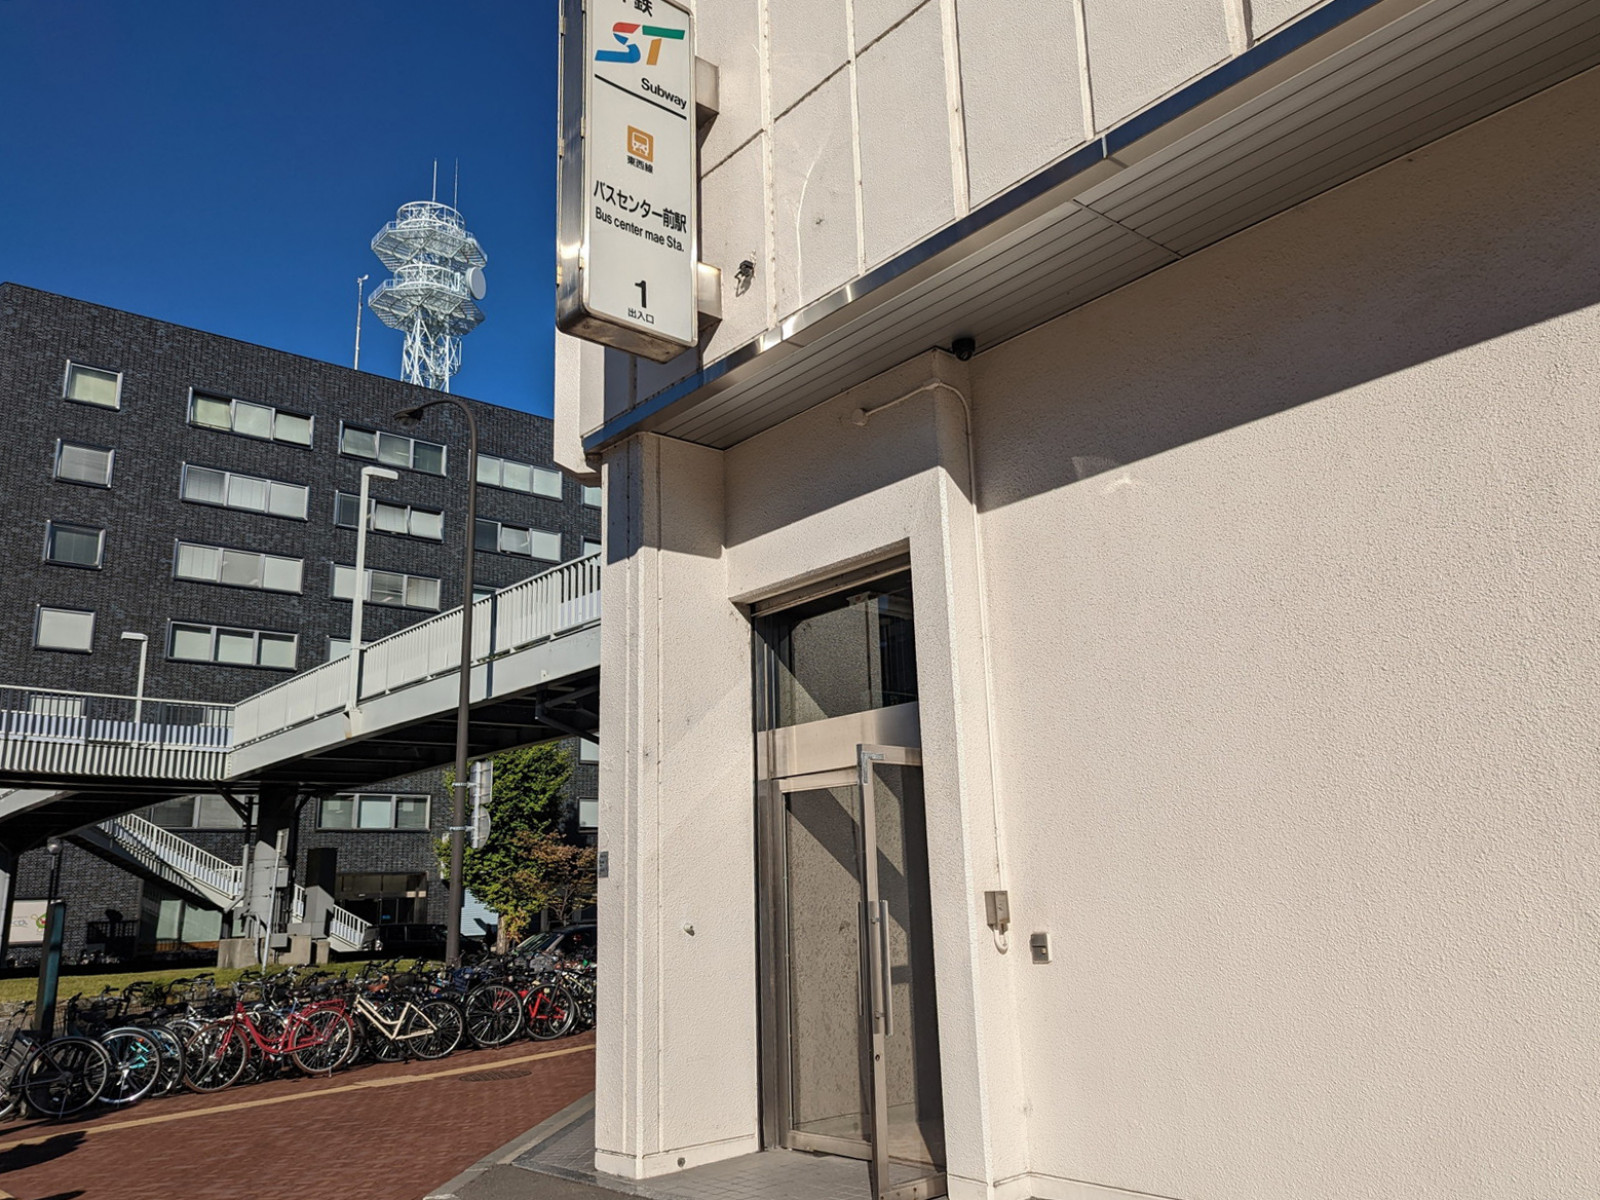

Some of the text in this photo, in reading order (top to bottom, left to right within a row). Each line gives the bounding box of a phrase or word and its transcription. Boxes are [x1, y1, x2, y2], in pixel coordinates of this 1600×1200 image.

[641, 77, 687, 110] Subway
[627, 155, 654, 174] 東西線
[594, 180, 687, 234] バスセンター前駅
[595, 206, 685, 252] Bus center mae Sta.
[634, 280, 647, 309] 1
[627, 308, 655, 325] 出入口
